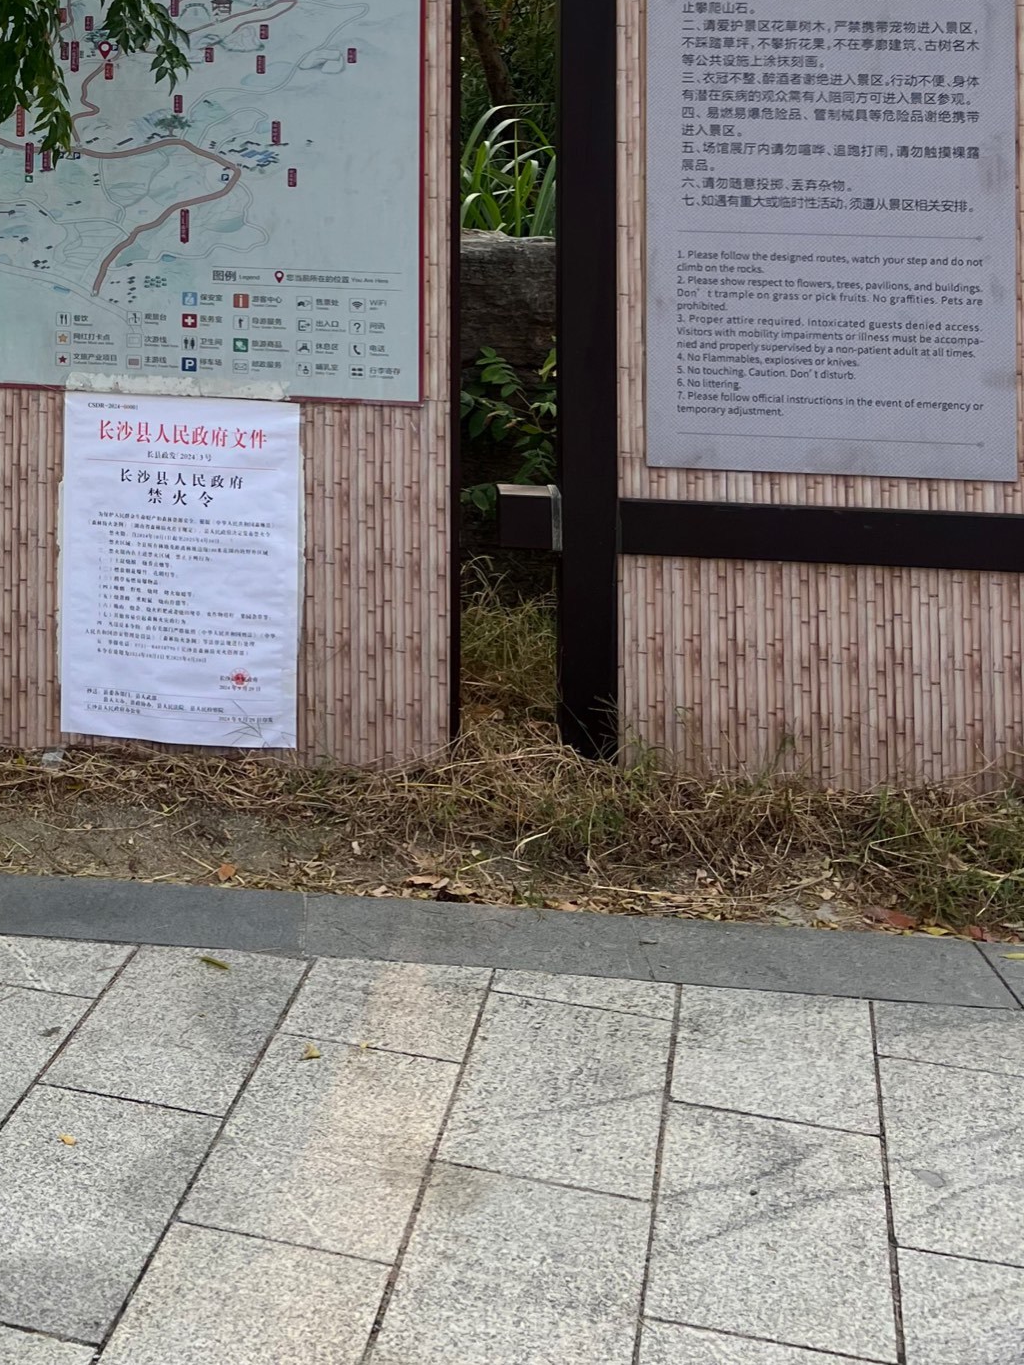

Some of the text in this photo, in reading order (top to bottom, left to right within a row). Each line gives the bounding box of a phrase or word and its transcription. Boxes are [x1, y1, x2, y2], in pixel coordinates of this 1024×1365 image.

[681, 124, 742, 137] 进入景区。
[681, 160, 716, 172] 展品。
[677, 250, 983, 266] 1. Please follow the designed routes, watch your step and do not
[676, 262, 702, 271] climb
[719, 263, 734, 272] the
[736, 264, 764, 273] rocks.
[212, 270, 237, 282] 图例
[676, 275, 982, 295] 2. Please show respect to flowers, trees, pavilions, and buildings.
[676, 352, 684, 360] 4.
[687, 352, 700, 361] No
[702, 352, 762, 364] Flammables,
[764, 355, 812, 366] explosives
[827, 357, 859, 366] knives.
[676, 377, 741, 391] 6. No littering.
[99, 419, 267, 450] 长沙县人民政府文件
[120, 468, 244, 489] 长沙县人民政府
[148, 487, 214, 508] 禁火令
